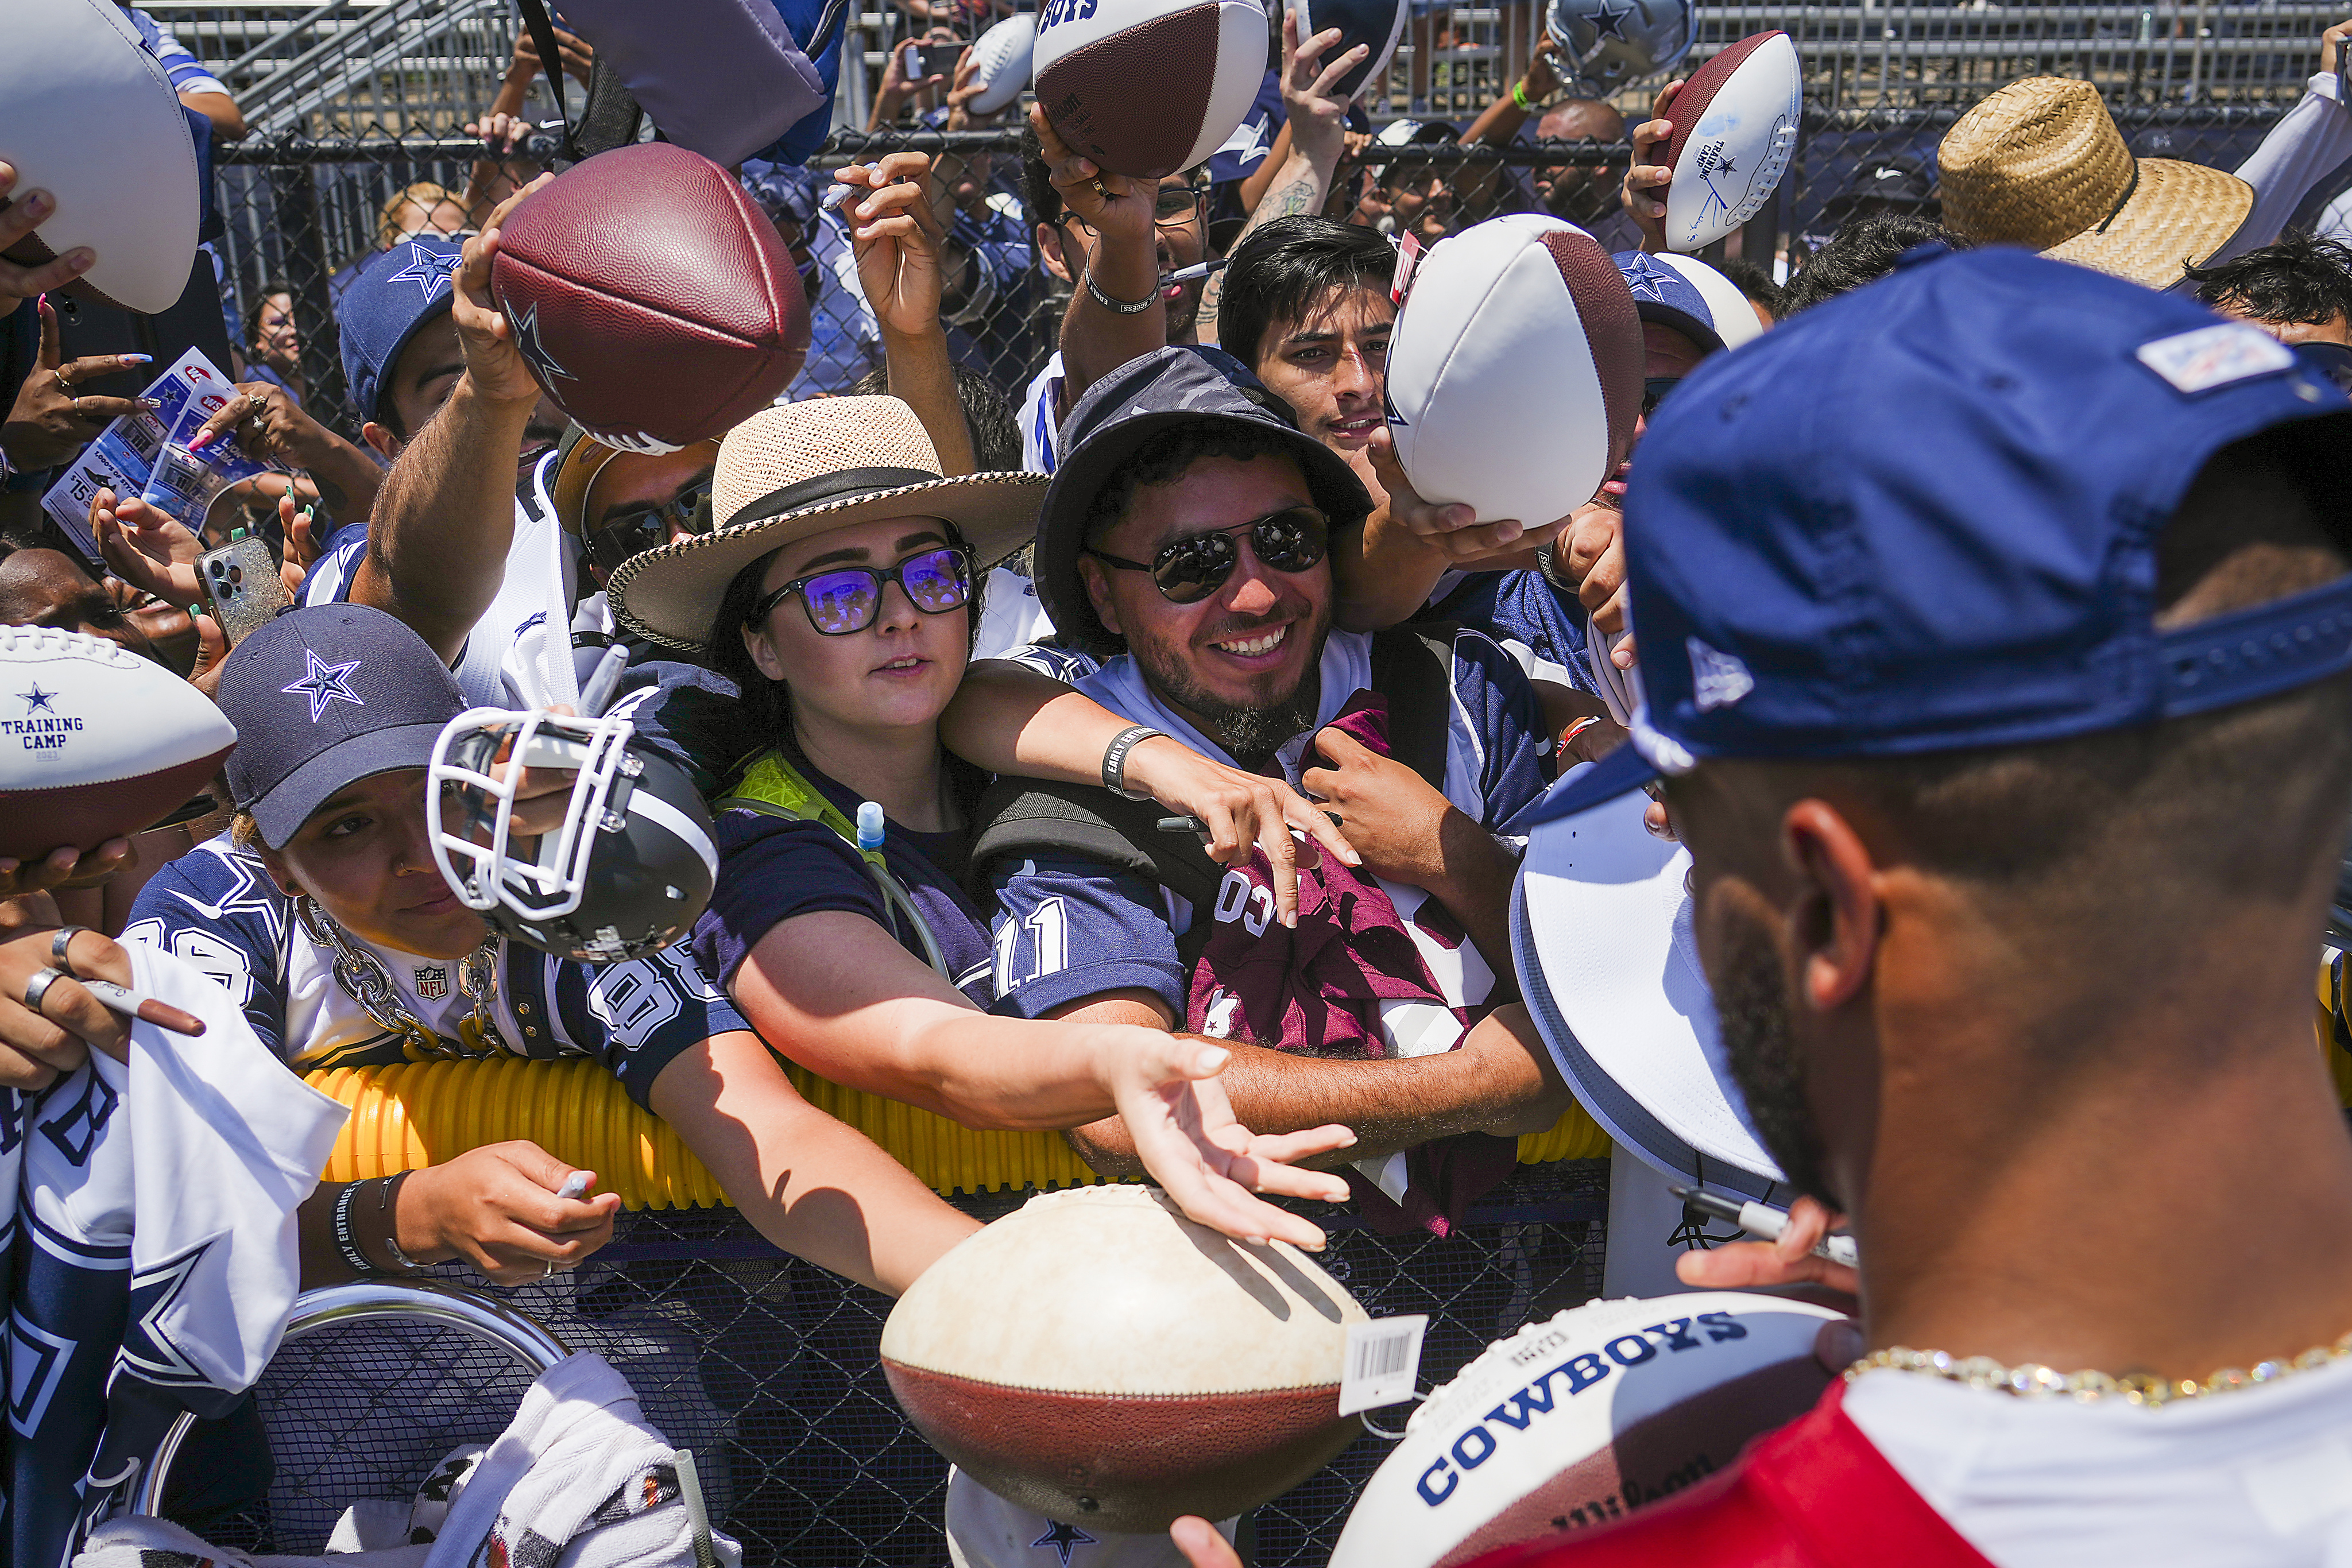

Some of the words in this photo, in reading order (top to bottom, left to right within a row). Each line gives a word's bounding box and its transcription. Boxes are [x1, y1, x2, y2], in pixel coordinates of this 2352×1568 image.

[1036, 0, 1098, 38] BOYS
[1696, 144, 1712, 168] CAMP
[1699, 140, 1725, 180] TRAINING
[1090, 285, 1108, 305] EARLY
[1123, 301, 1148, 311] ACCESS
[203, 396, 225, 412] WS
[113, 471, 121, 479] OF
[1, 718, 84, 734] TRAINING
[23, 734, 67, 749] CAMP
[1107, 742, 1125, 774] EARLY
[995, 896, 1070, 1002] 11
[419, 980, 446, 997] NFL
[336, 1187, 357, 1242] ENTRANCE
[342, 1245, 372, 1271] EARLY
[1416, 1311, 1747, 1507] COWBOYS
